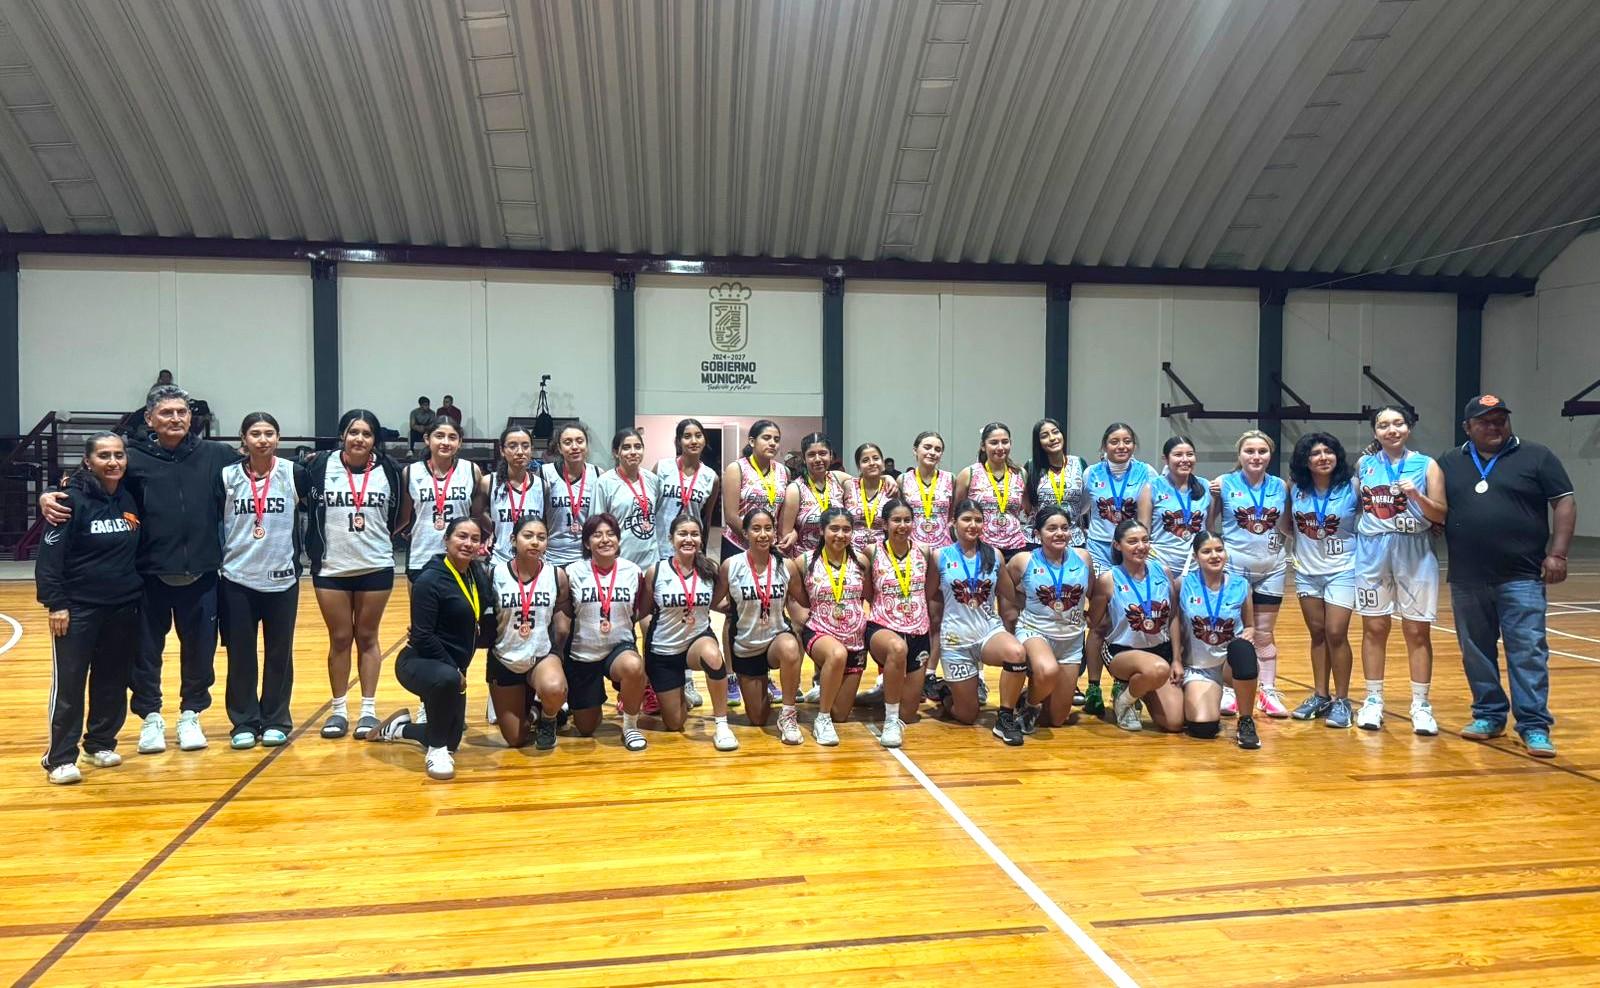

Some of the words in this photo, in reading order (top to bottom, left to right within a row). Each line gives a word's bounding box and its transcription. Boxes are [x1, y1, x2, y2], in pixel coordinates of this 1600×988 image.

[701, 360, 756, 373] GOBIERNO
[701, 372, 758, 385] MUNICIPAL
[419, 486, 466, 502] EAES
[551, 496, 591, 508] EAGES
[663, 484, 705, 504] EAGES
[1371, 495, 1394, 504] PUEBLA
[1395, 516, 1416, 534] 99
[1327, 538, 1344, 556] 18
[1358, 588, 1378, 608] 99
[950, 663, 969, 679] 23
